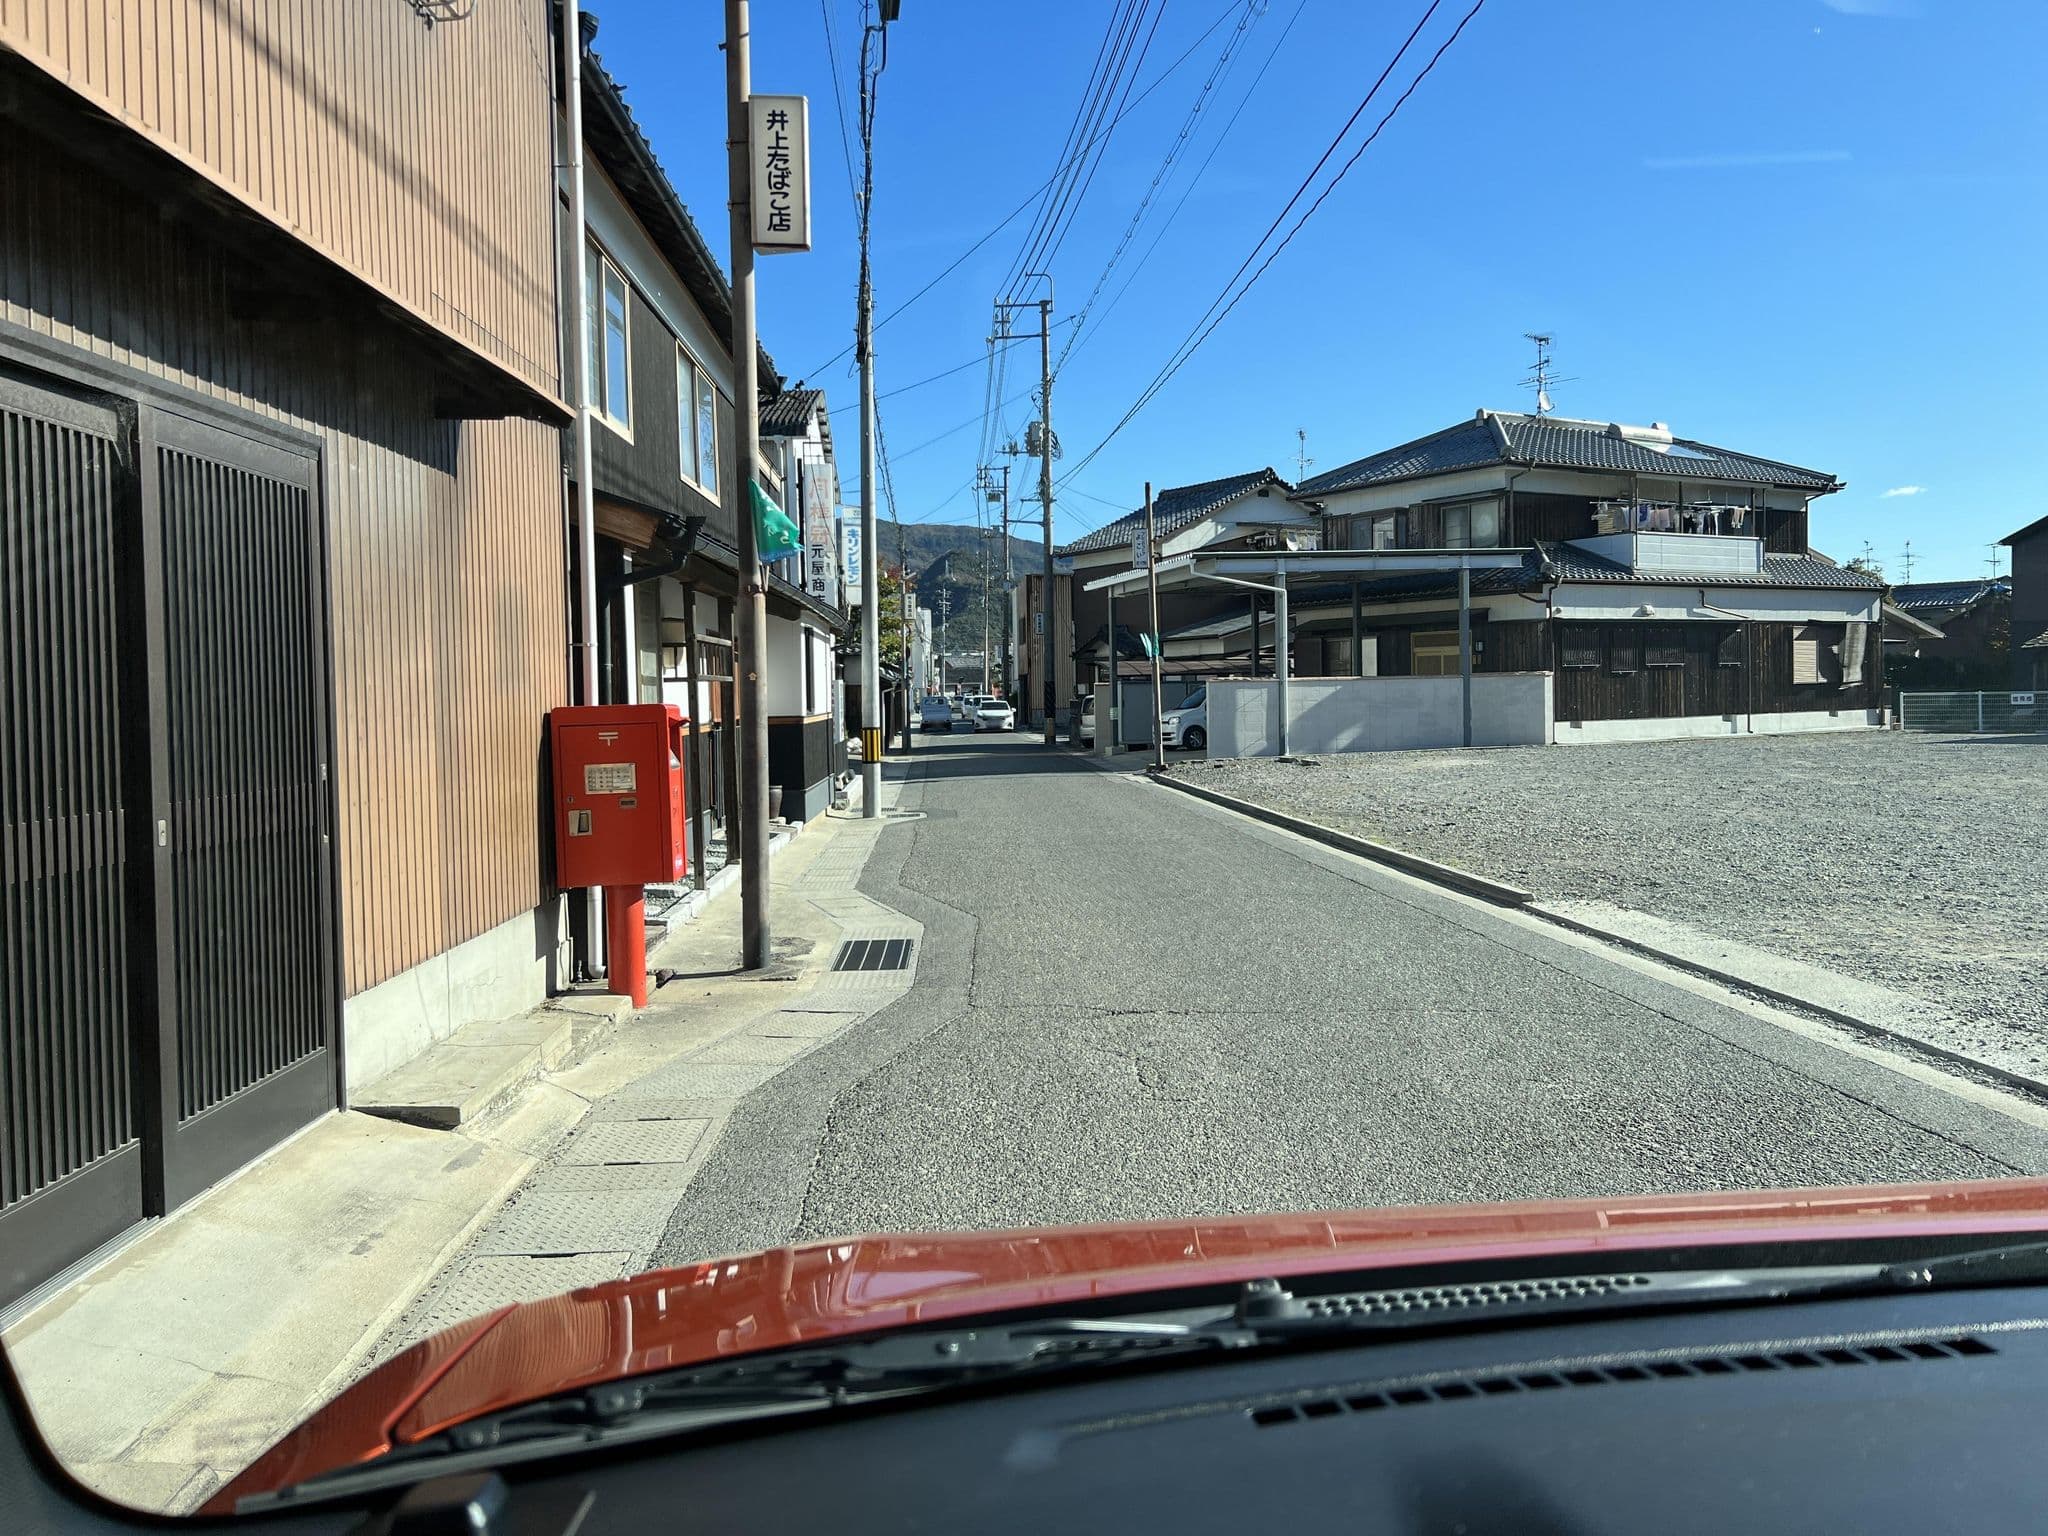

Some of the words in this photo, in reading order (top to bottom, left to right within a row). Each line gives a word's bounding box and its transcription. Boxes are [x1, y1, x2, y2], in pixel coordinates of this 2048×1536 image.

[766, 109, 792, 232] 井上たばこ店
[847, 528, 860, 584] キリンレモン
